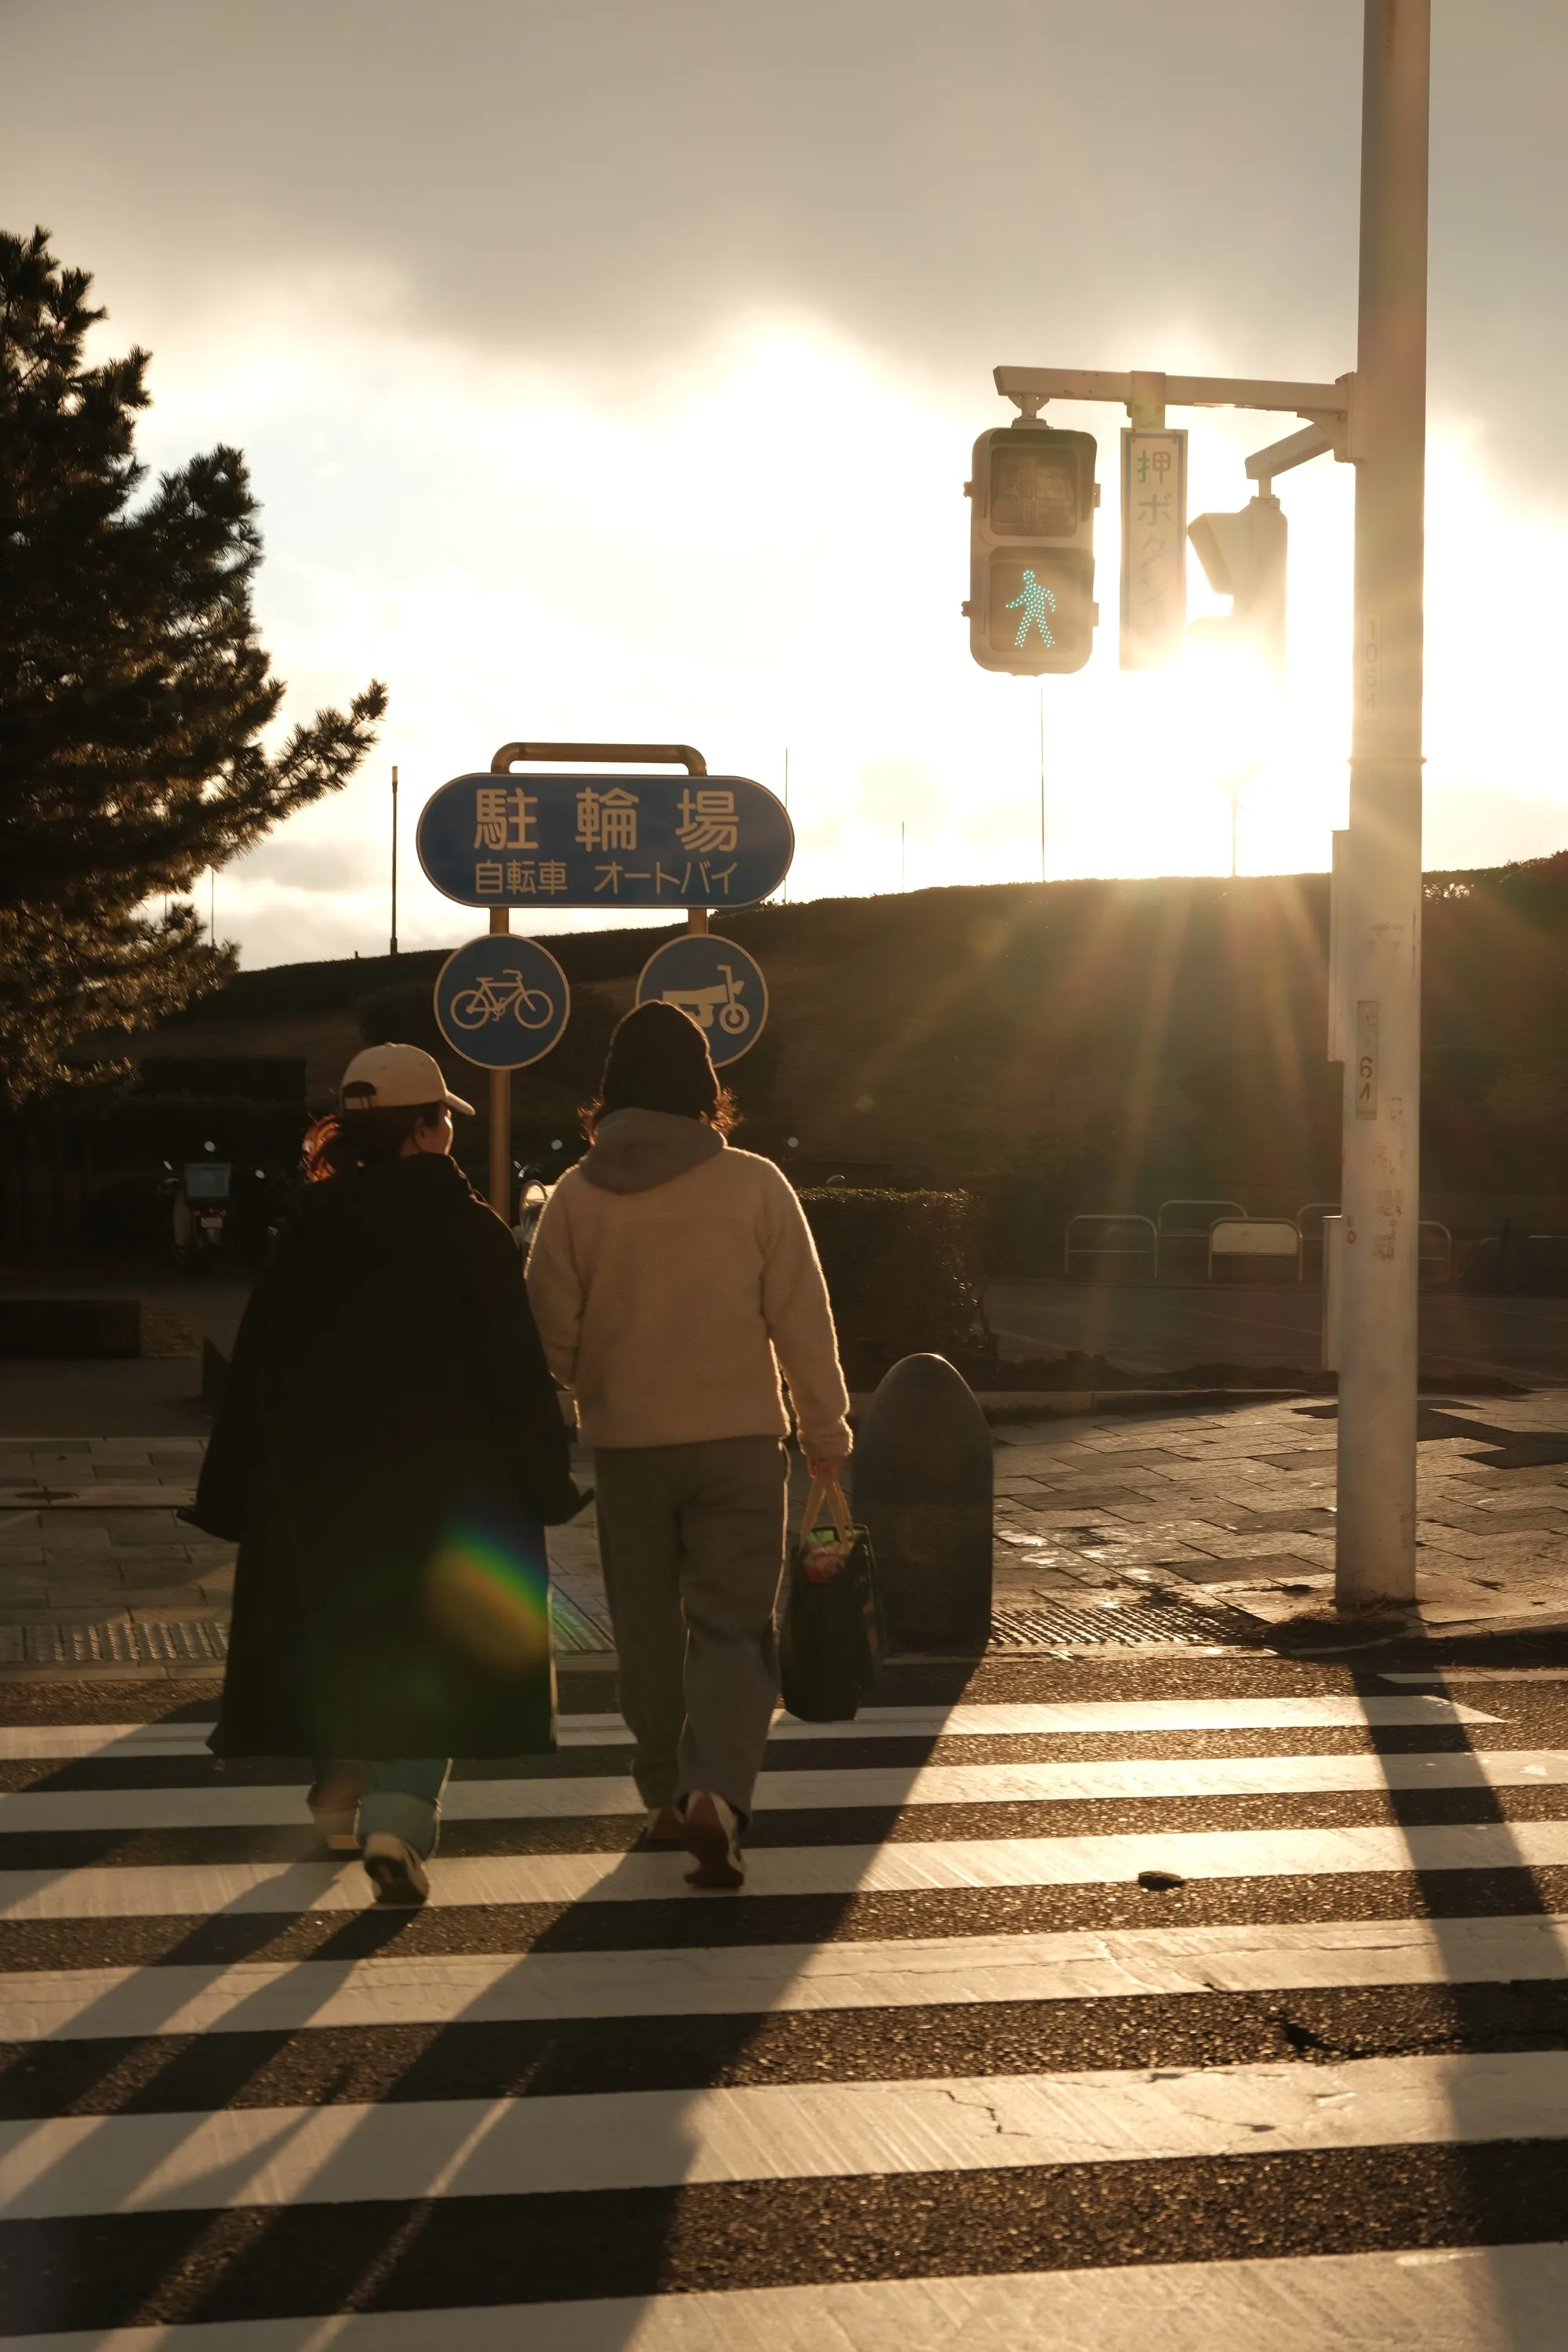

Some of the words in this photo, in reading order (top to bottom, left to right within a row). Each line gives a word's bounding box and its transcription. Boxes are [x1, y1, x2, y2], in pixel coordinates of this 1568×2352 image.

[1136, 448, 1173, 607] 押ボタン
[474, 786, 739, 852] 駐輪場
[475, 859, 568, 895] 自転車
[593, 860, 738, 895] オートバイ
